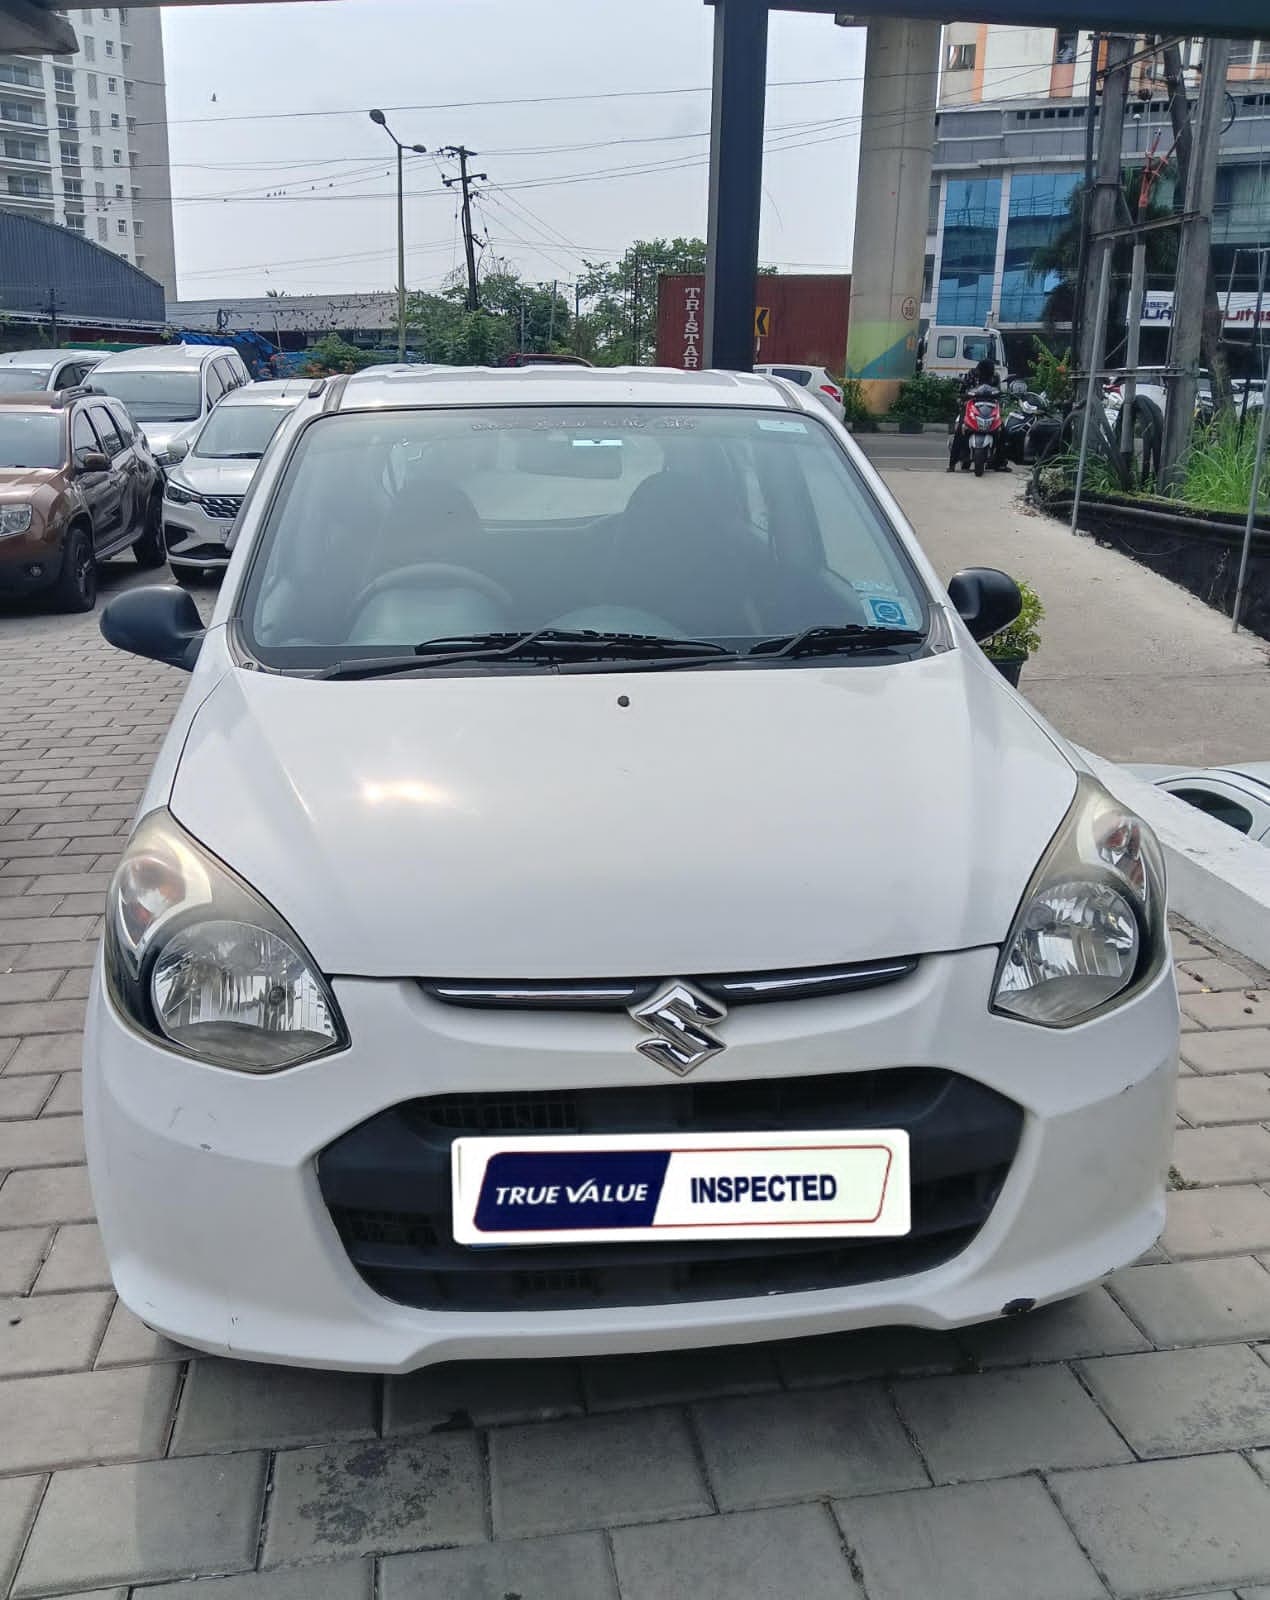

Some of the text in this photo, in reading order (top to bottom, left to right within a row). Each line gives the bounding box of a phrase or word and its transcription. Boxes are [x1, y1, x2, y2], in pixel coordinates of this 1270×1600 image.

[683, 287, 700, 368] TRISTAR
[496, 1174, 837, 1205] TRUE VALUE INSPECTED
